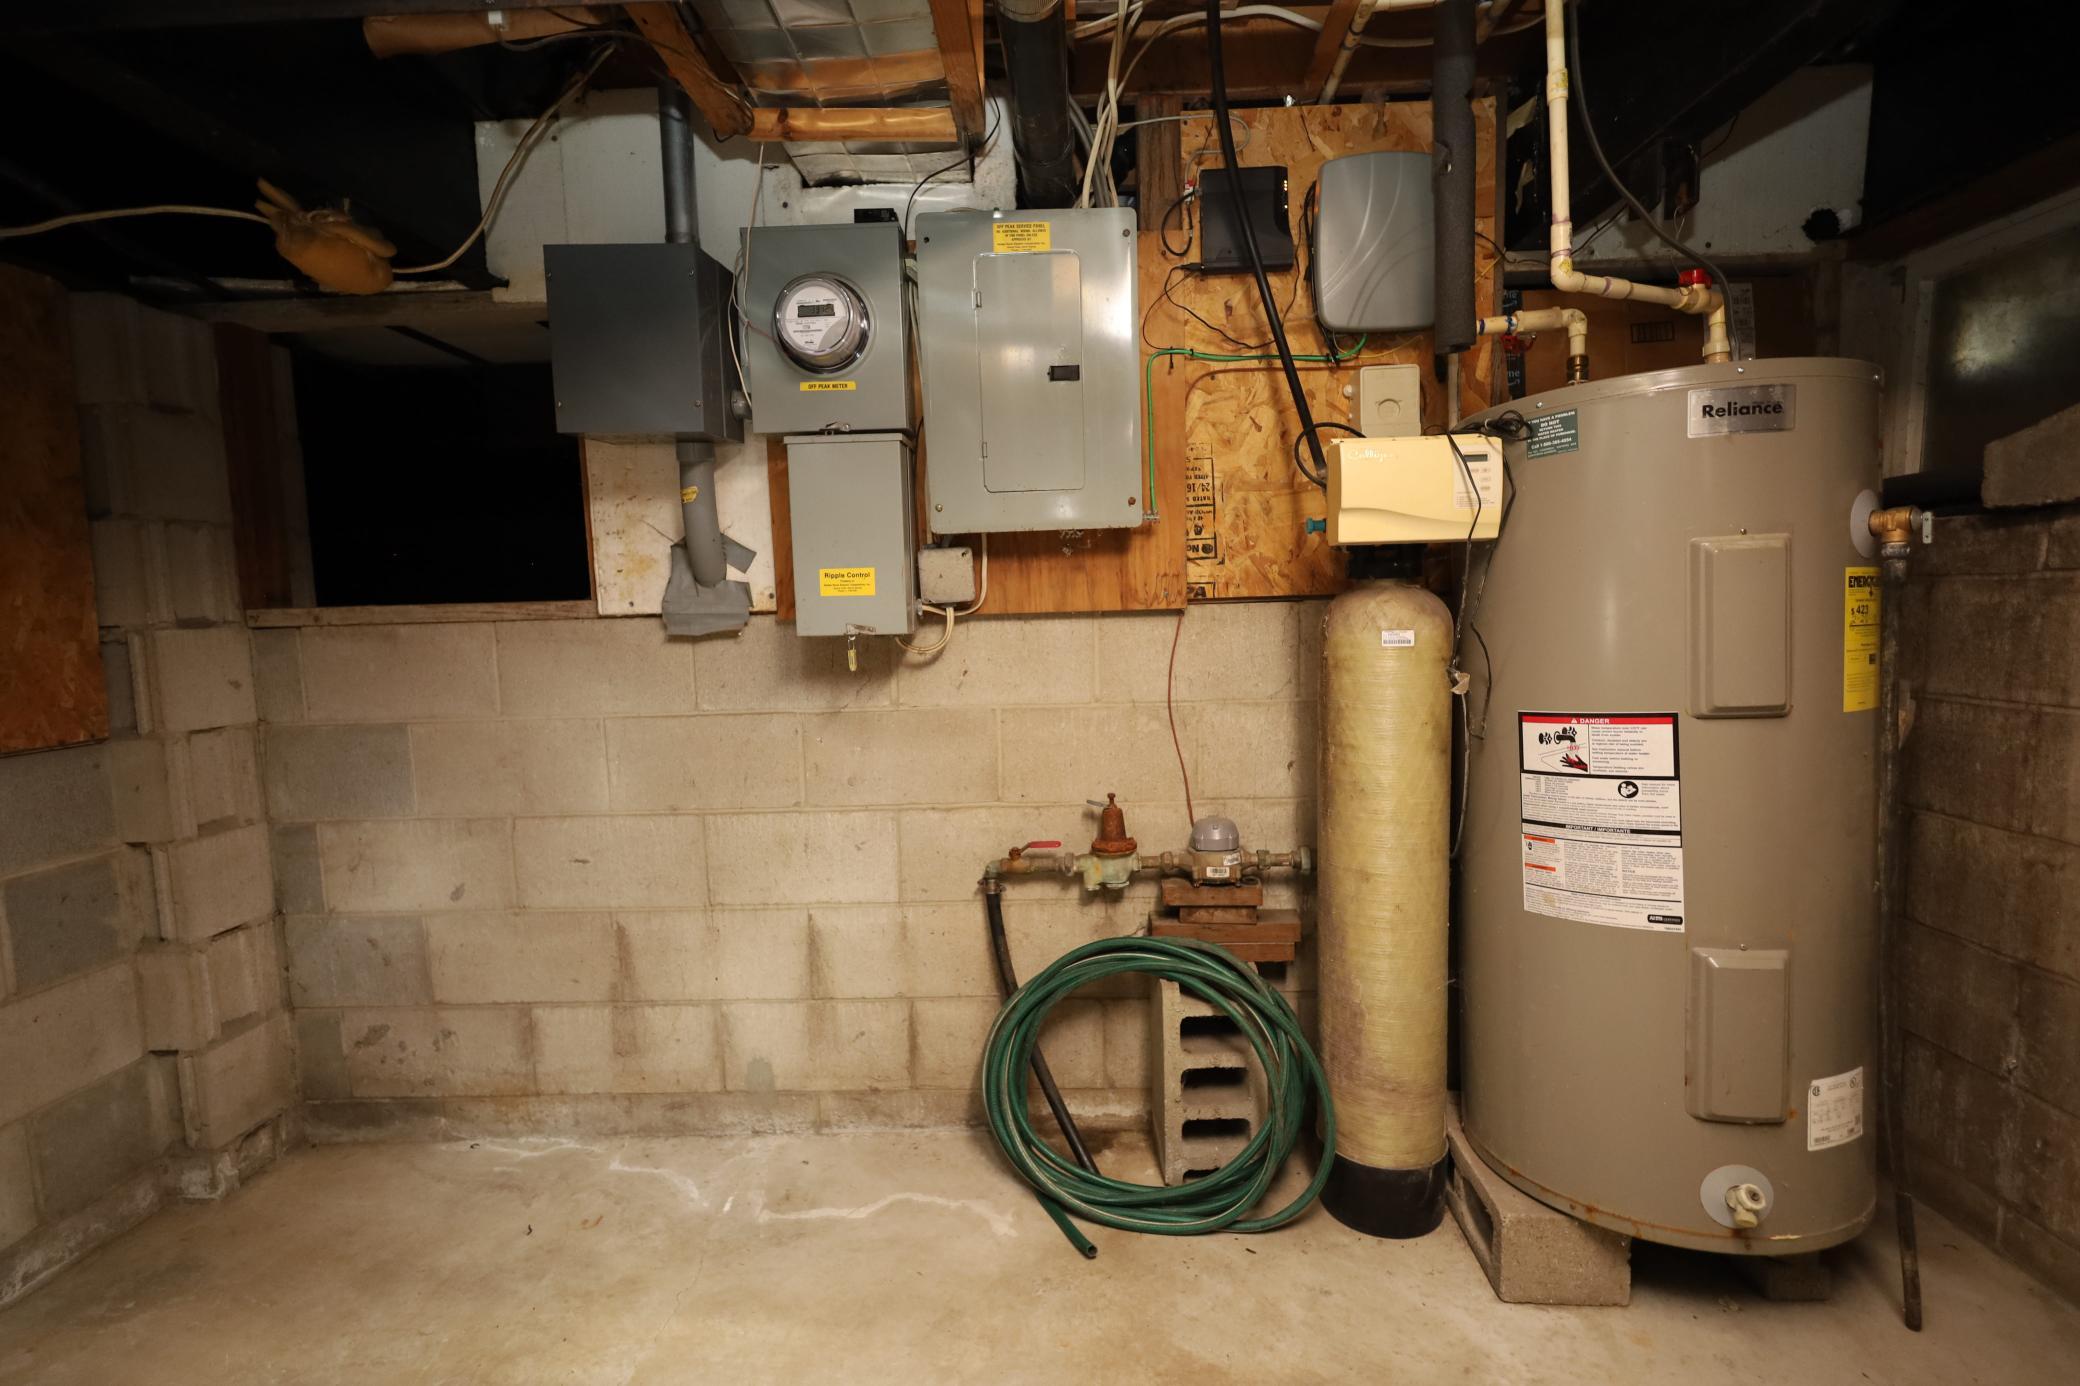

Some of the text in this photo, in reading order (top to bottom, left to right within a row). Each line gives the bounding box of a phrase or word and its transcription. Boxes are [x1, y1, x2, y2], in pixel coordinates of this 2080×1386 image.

[1702, 401, 1783, 419] Reliance
[1187, 483, 1210, 493] 24/16
[824, 571, 871, 580] Ripple Control
[1856, 604, 1869, 615] 423
